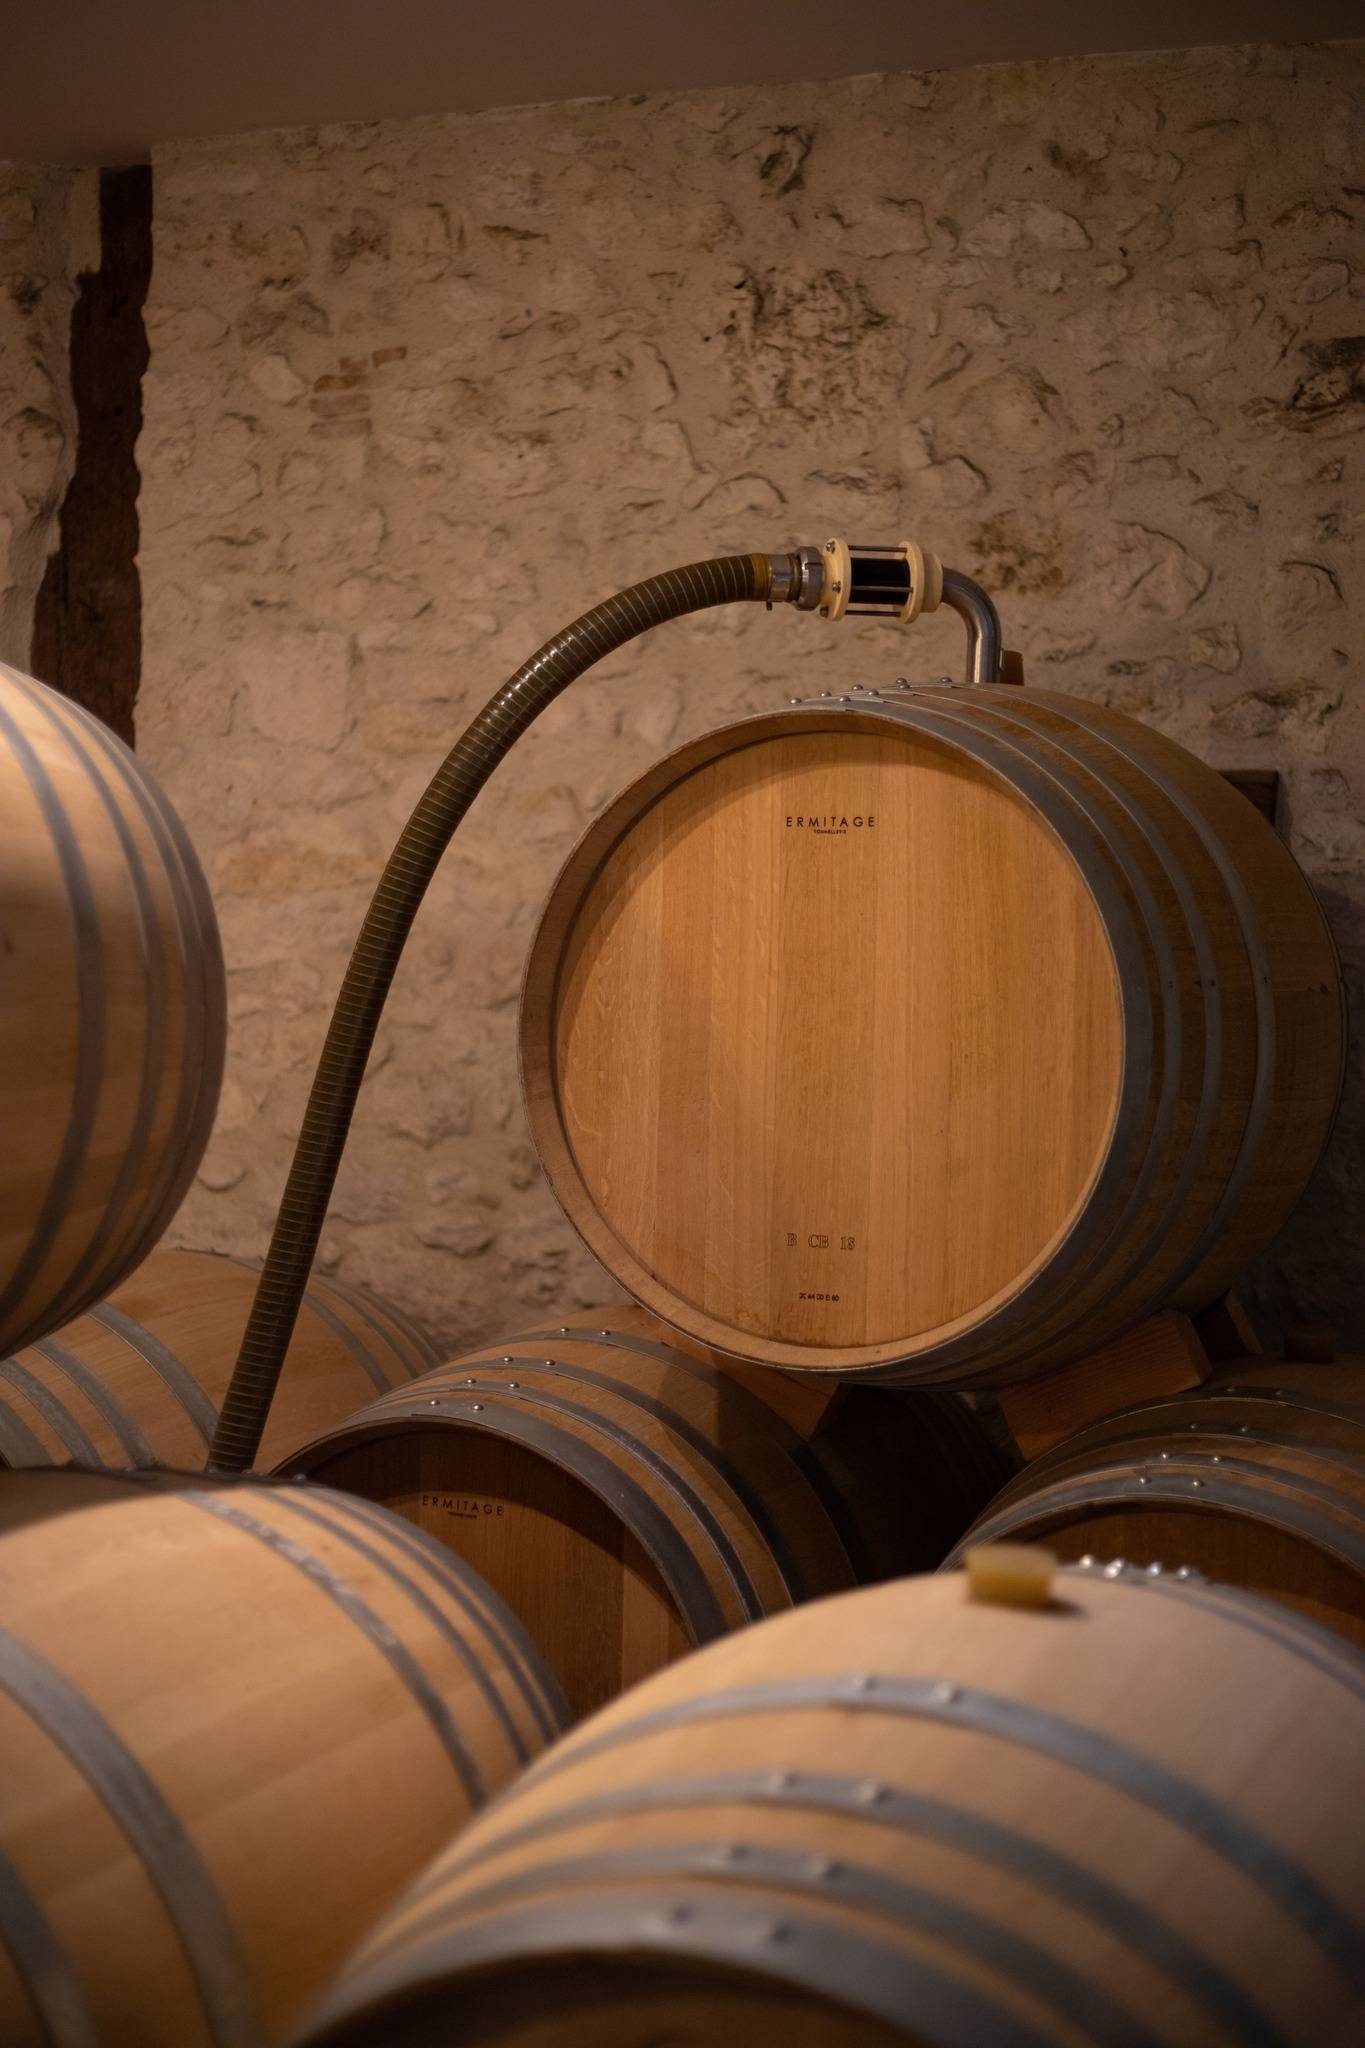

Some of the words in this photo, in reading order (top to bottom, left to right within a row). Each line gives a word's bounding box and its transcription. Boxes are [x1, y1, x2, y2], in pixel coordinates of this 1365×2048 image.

[785, 816, 876, 828] ERMITAGE
[786, 1232, 798, 1247] B
[807, 1234, 830, 1249] CB
[422, 1495, 504, 1516] ERMITAGE
